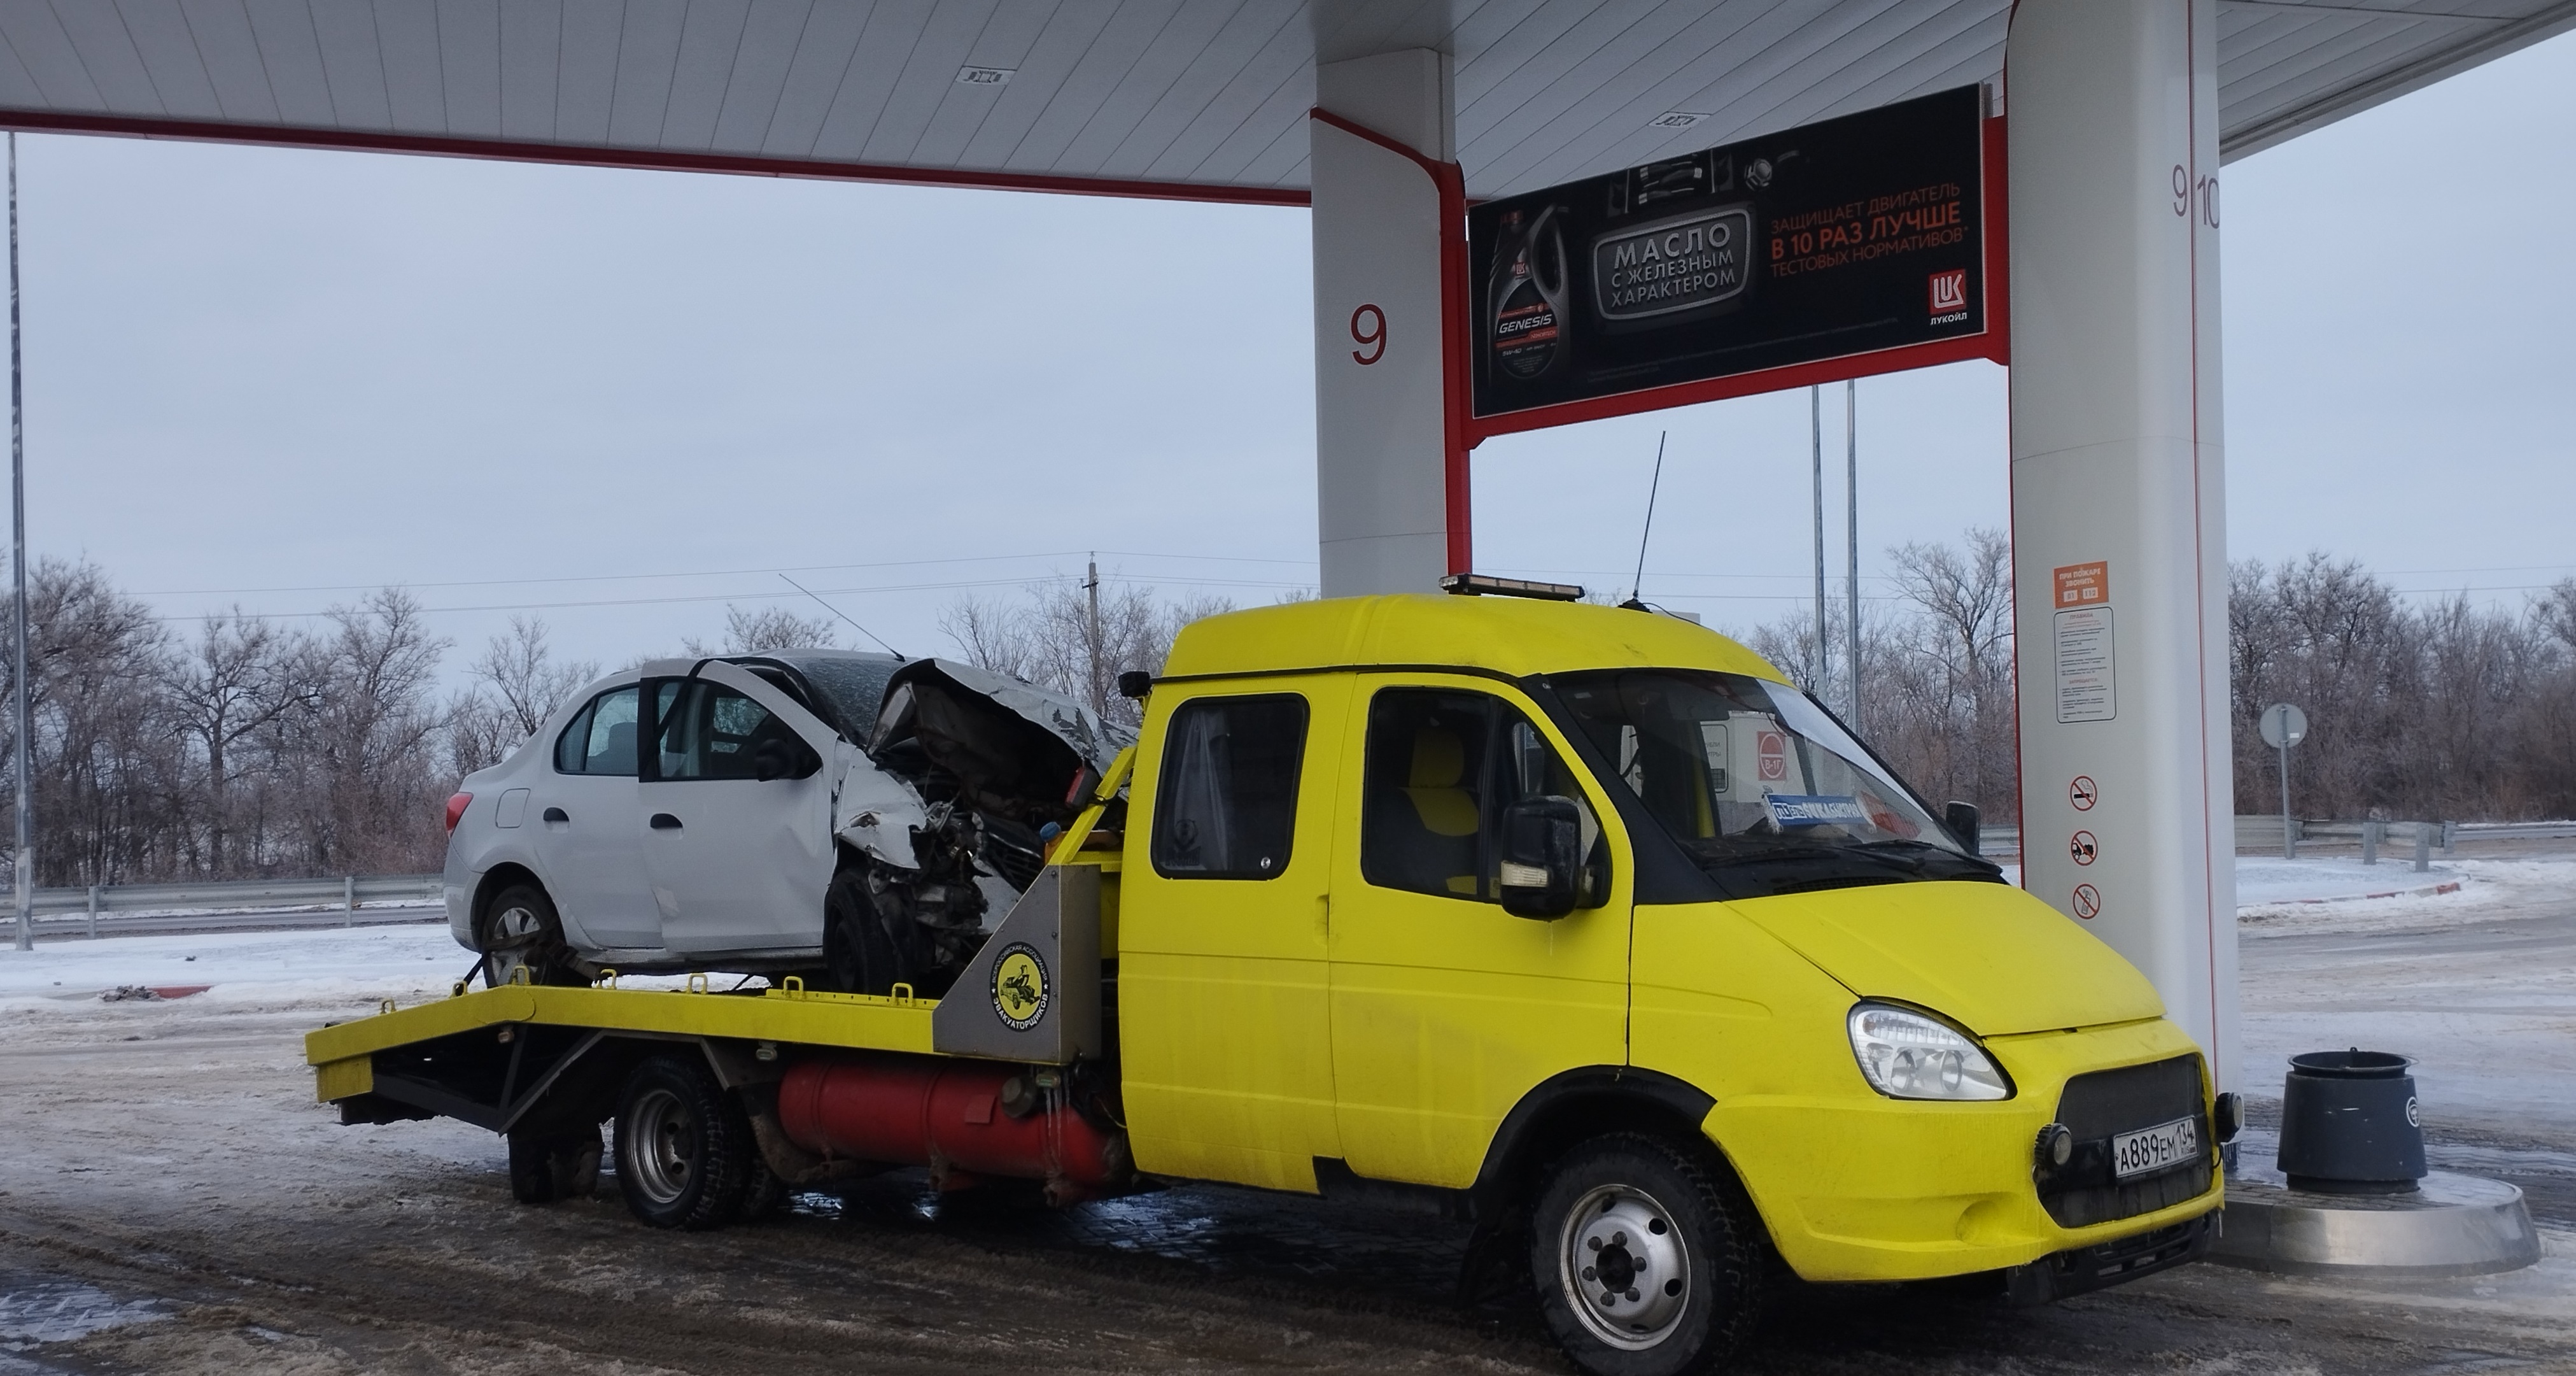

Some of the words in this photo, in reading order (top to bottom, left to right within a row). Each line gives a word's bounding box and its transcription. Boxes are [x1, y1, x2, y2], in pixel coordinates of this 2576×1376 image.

[1771, 202, 1864, 234] ЗАЩИЩАЕТ
[1868, 182, 1960, 216] ДВИГАТЕЛЬ
[2172, 164, 2187, 217] 9
[2197, 174, 2220, 229] 10
[1614, 223, 1730, 269] МАСЛО
[1771, 238, 1784, 260] В
[1791, 232, 1812, 255] 10
[1820, 222, 1862, 250] РАЗ
[1869, 201, 1960, 240] ЛУЧШЕ
[1612, 273, 1621, 287] С
[1628, 249, 1733, 285] ЖЕЛЕЗНЫМ
[1770, 252, 1849, 278] ТЕСТОВЫХ
[1611, 268, 1735, 308] ХАРАКТЕРОМ
[1351, 304, 1387, 365] 9
[1499, 314, 1552, 334] GENESIS
[1930, 311, 1967, 326] ЛУКОЙЛ
[2065, 577, 2095, 588] ЗВОНИТЬ
[2073, 567, 2101, 578] ПОЖАРЕ
[993, 993, 1048, 1030] ЭВАКУАТОРЩИКОВ
[2176, 1121, 2194, 1145] 134
